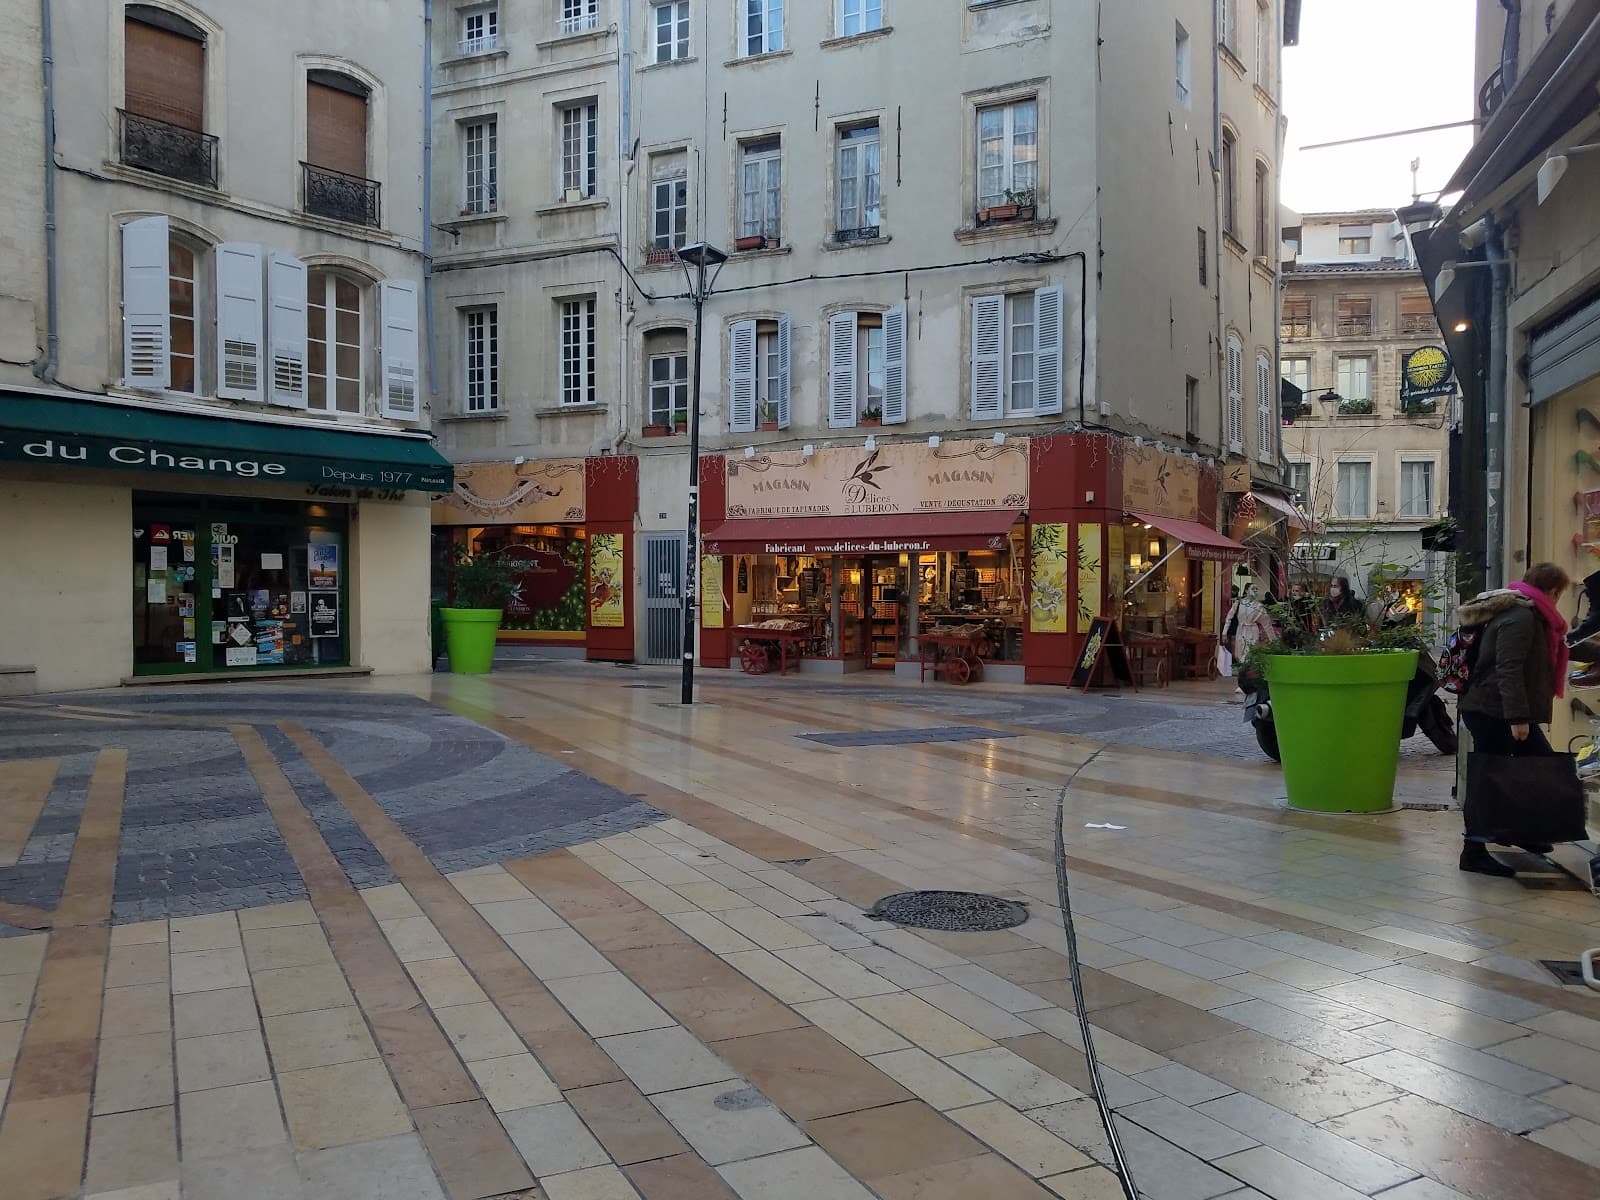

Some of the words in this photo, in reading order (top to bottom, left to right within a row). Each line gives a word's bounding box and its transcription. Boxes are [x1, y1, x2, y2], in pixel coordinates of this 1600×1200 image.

[23, 440, 87, 460] du
[109, 446, 287, 477] Change
[322, 465, 374, 482] Depuis
[380, 470, 414, 484] 1977
[928, 469, 994, 486] MAGASIN
[752, 478, 813, 493] MAGASIN
[852, 503, 900, 513] LUBERON
[765, 543, 807, 553] Fabricant
[814, 540, 931, 553] www.delices-du-luberon.fr
